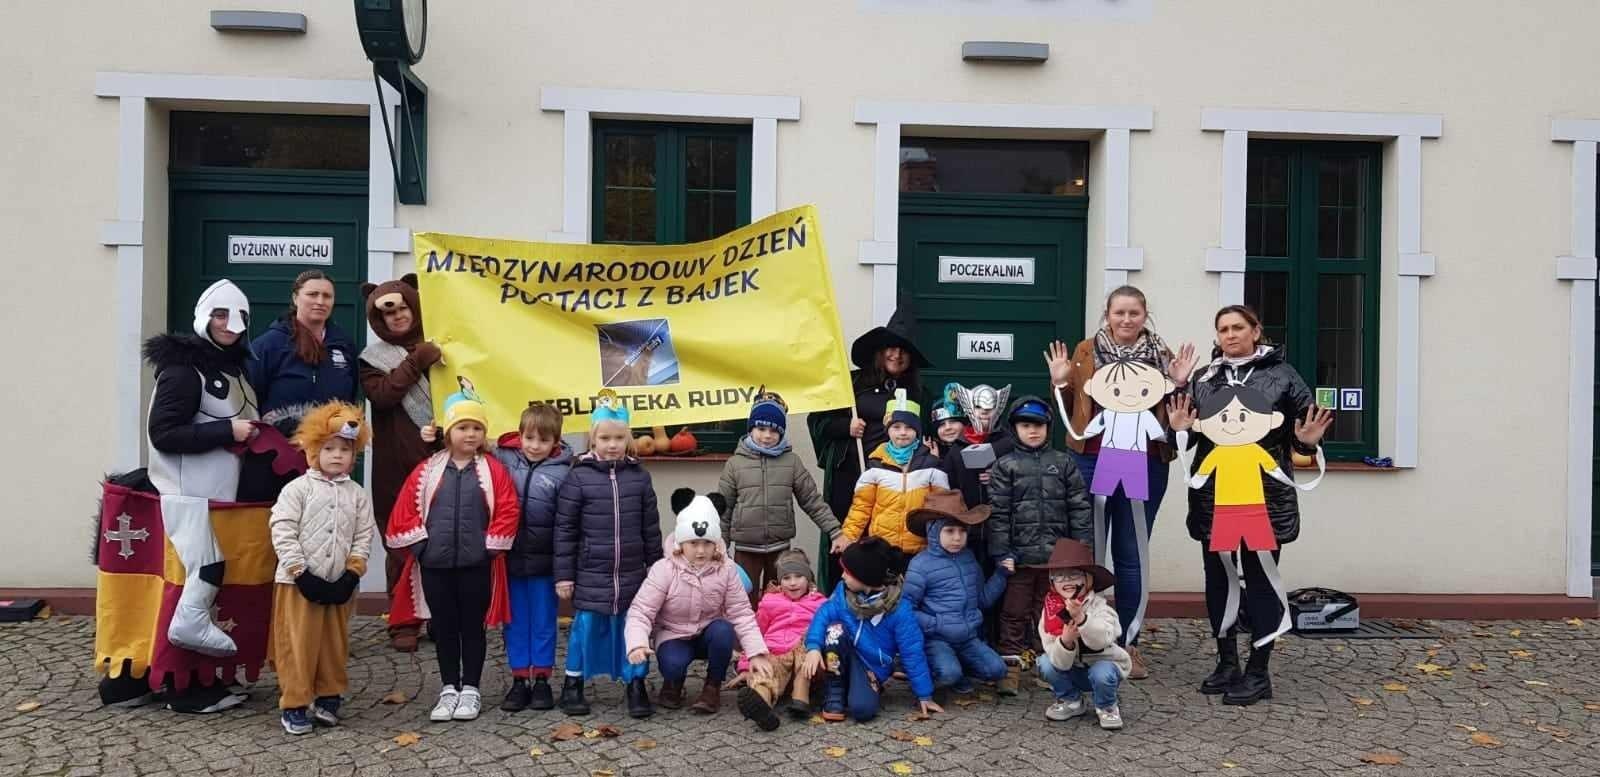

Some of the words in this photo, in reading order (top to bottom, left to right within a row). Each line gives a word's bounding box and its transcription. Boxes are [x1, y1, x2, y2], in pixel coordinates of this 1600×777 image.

[232, 242, 286, 257] DYŻURNY
[289, 244, 329, 258] RUCHU
[426, 250, 716, 283] MIĘDZYNARODOWY
[723, 216, 806, 267] DZIEŃ
[949, 263, 1025, 278] POCZEKALNIA
[637, 286, 656, 307] Z
[666, 268, 760, 305] BAJEK
[970, 340, 1001, 353] KASA
[528, 391, 682, 416] BLITEKA
[688, 386, 755, 409] RUDY
